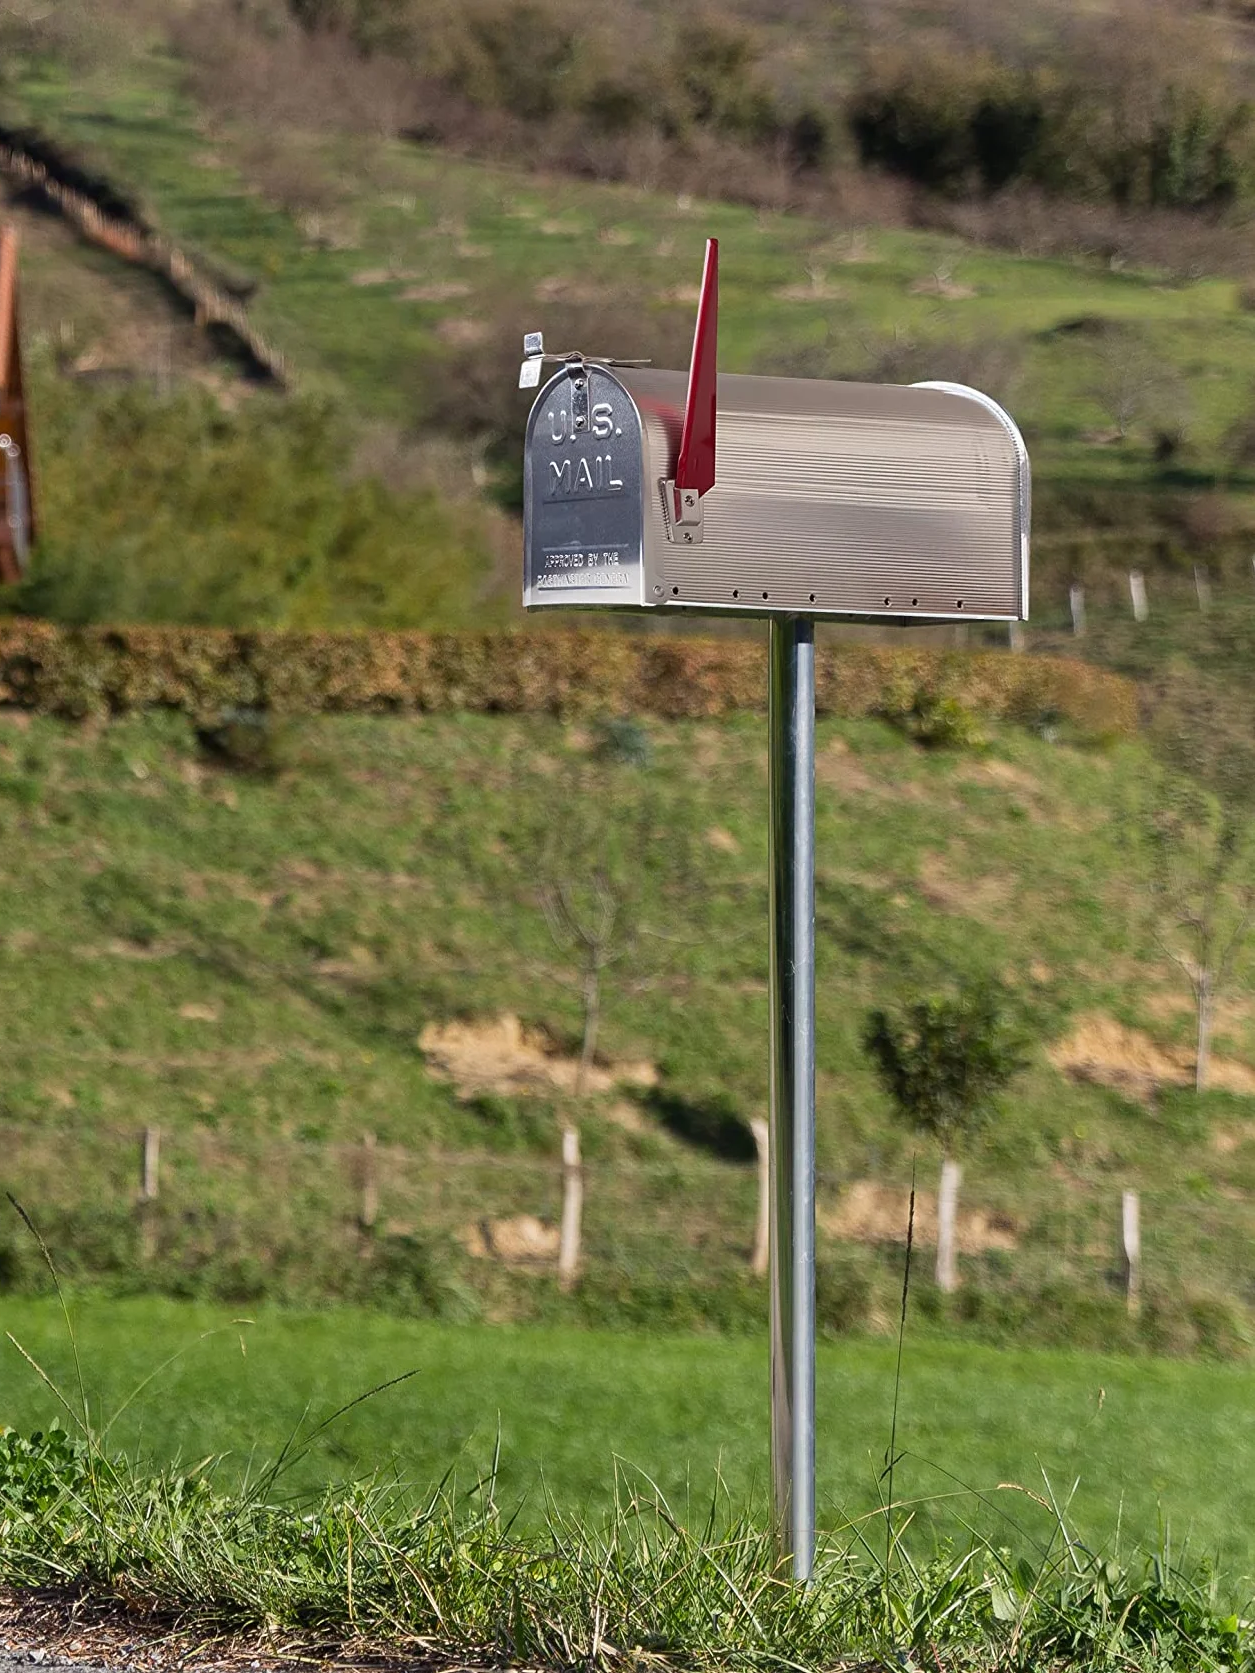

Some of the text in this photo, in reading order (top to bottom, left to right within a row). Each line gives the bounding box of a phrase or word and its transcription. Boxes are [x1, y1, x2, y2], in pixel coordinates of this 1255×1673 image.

[549, 454, 623, 496] MAIL
[544, 551, 620, 568] APPROVED BY THE
